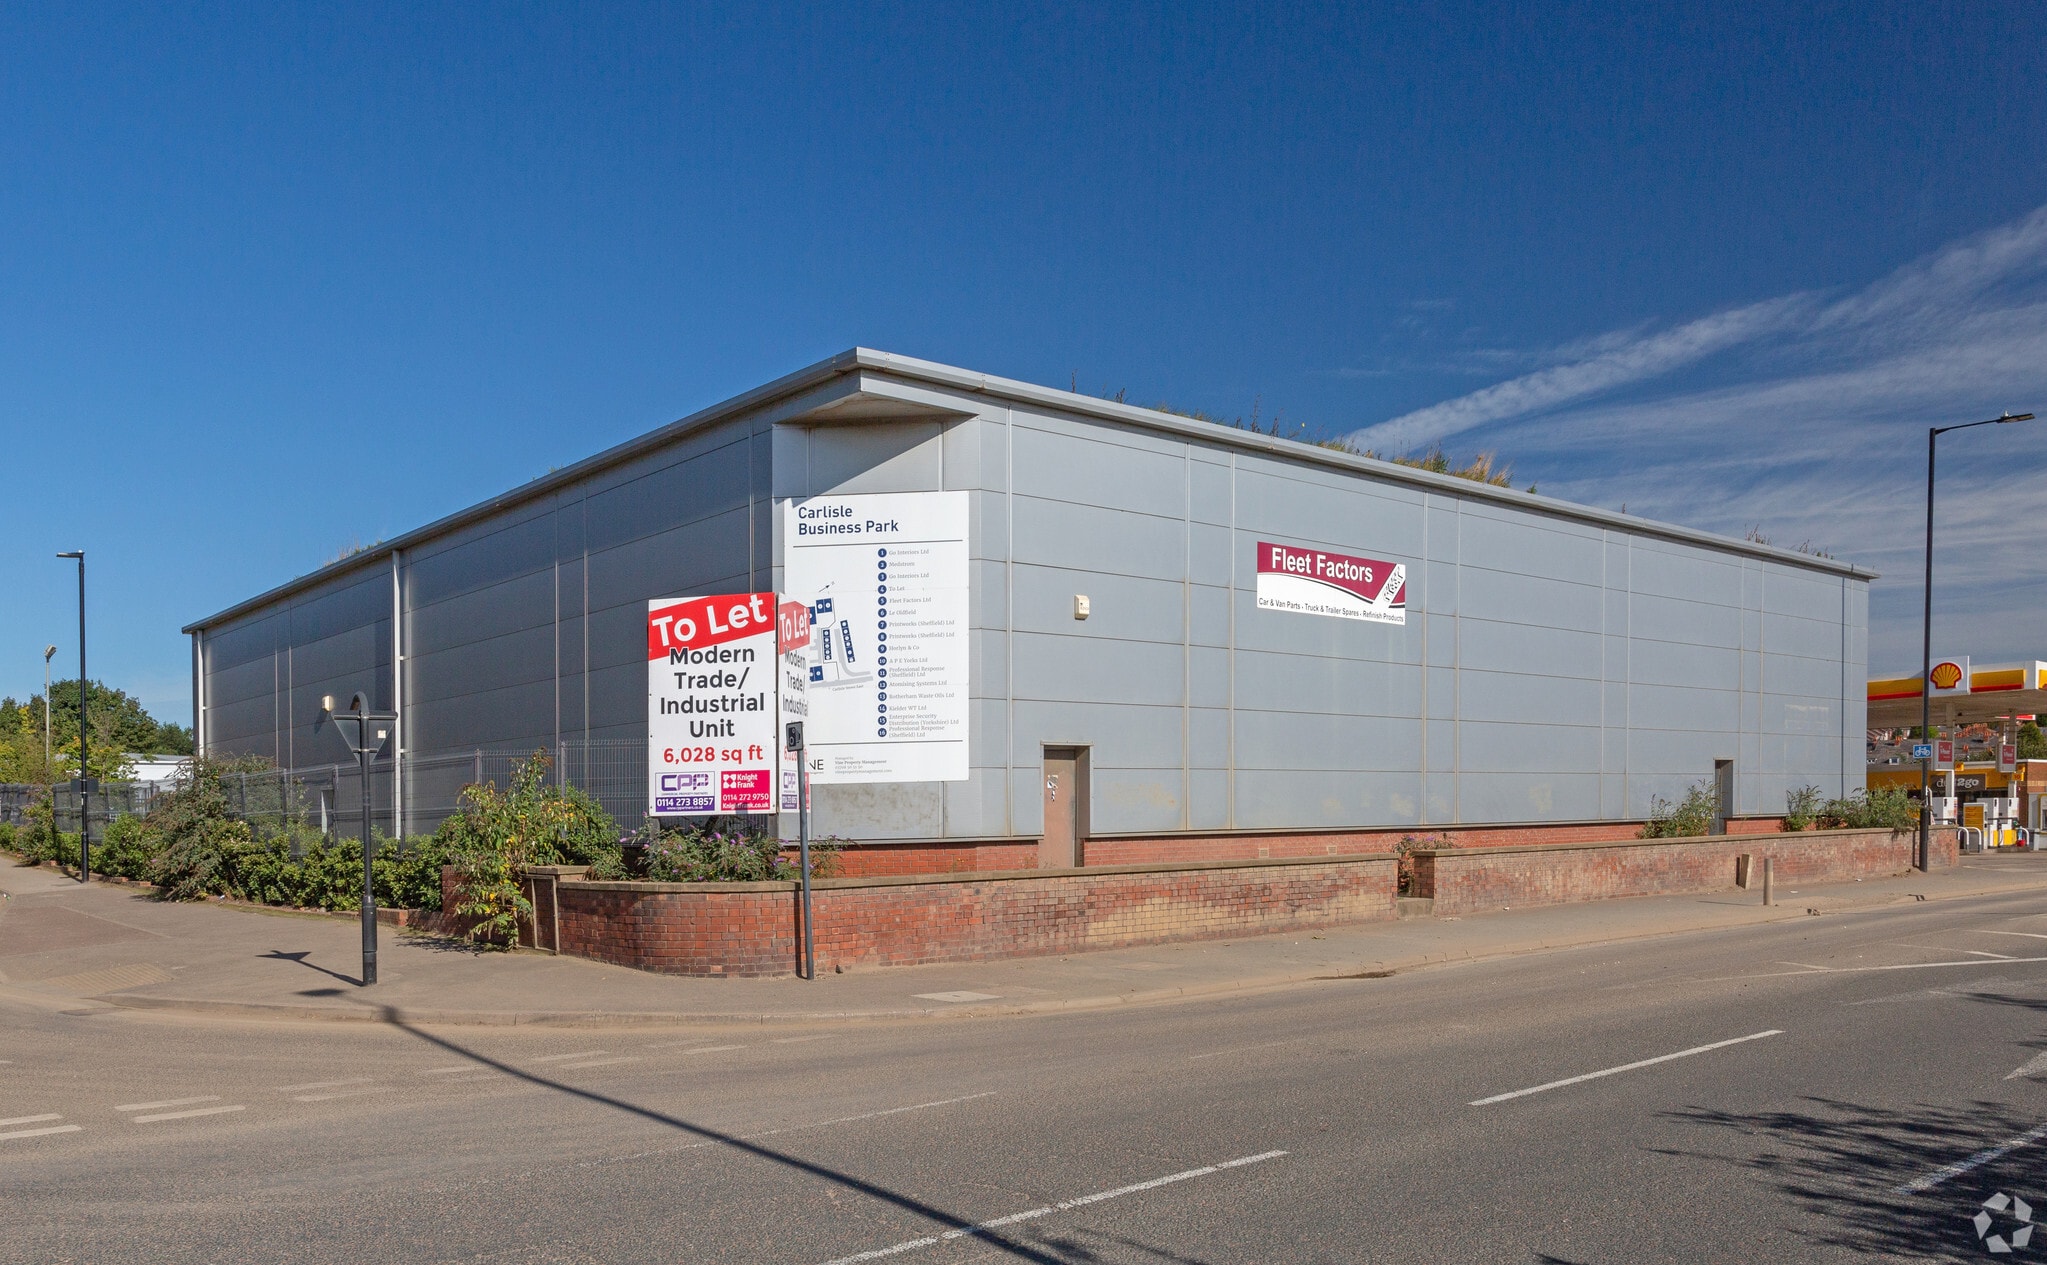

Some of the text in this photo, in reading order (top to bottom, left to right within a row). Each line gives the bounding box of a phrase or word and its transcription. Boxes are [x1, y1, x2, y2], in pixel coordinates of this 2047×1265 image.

[798, 505, 853, 518] Carlisle
[798, 520, 898, 535] Business Park
[1272, 547, 1373, 583] Fleet Factors
[652, 594, 768, 646] To Let
[1287, 601, 1300, 609] Parts
[1326, 606, 1341, 614] Trailer
[1343, 608, 1359, 616] Spares
[1383, 613, 1404, 622] Products
[780, 608, 808, 642] To Let
[670, 645, 754, 665] Modern
[784, 645, 806, 670] Modern
[674, 667, 750, 690] Trade/
[786, 671, 805, 694] Trade/
[660, 692, 764, 714] Industrial
[690, 718, 735, 738] Unit
[663, 745, 763, 765] 6,028 sq ft
[661, 774, 709, 791] CPP
[737, 773, 758, 782] Knight
[693, 798, 713, 806] 8857
